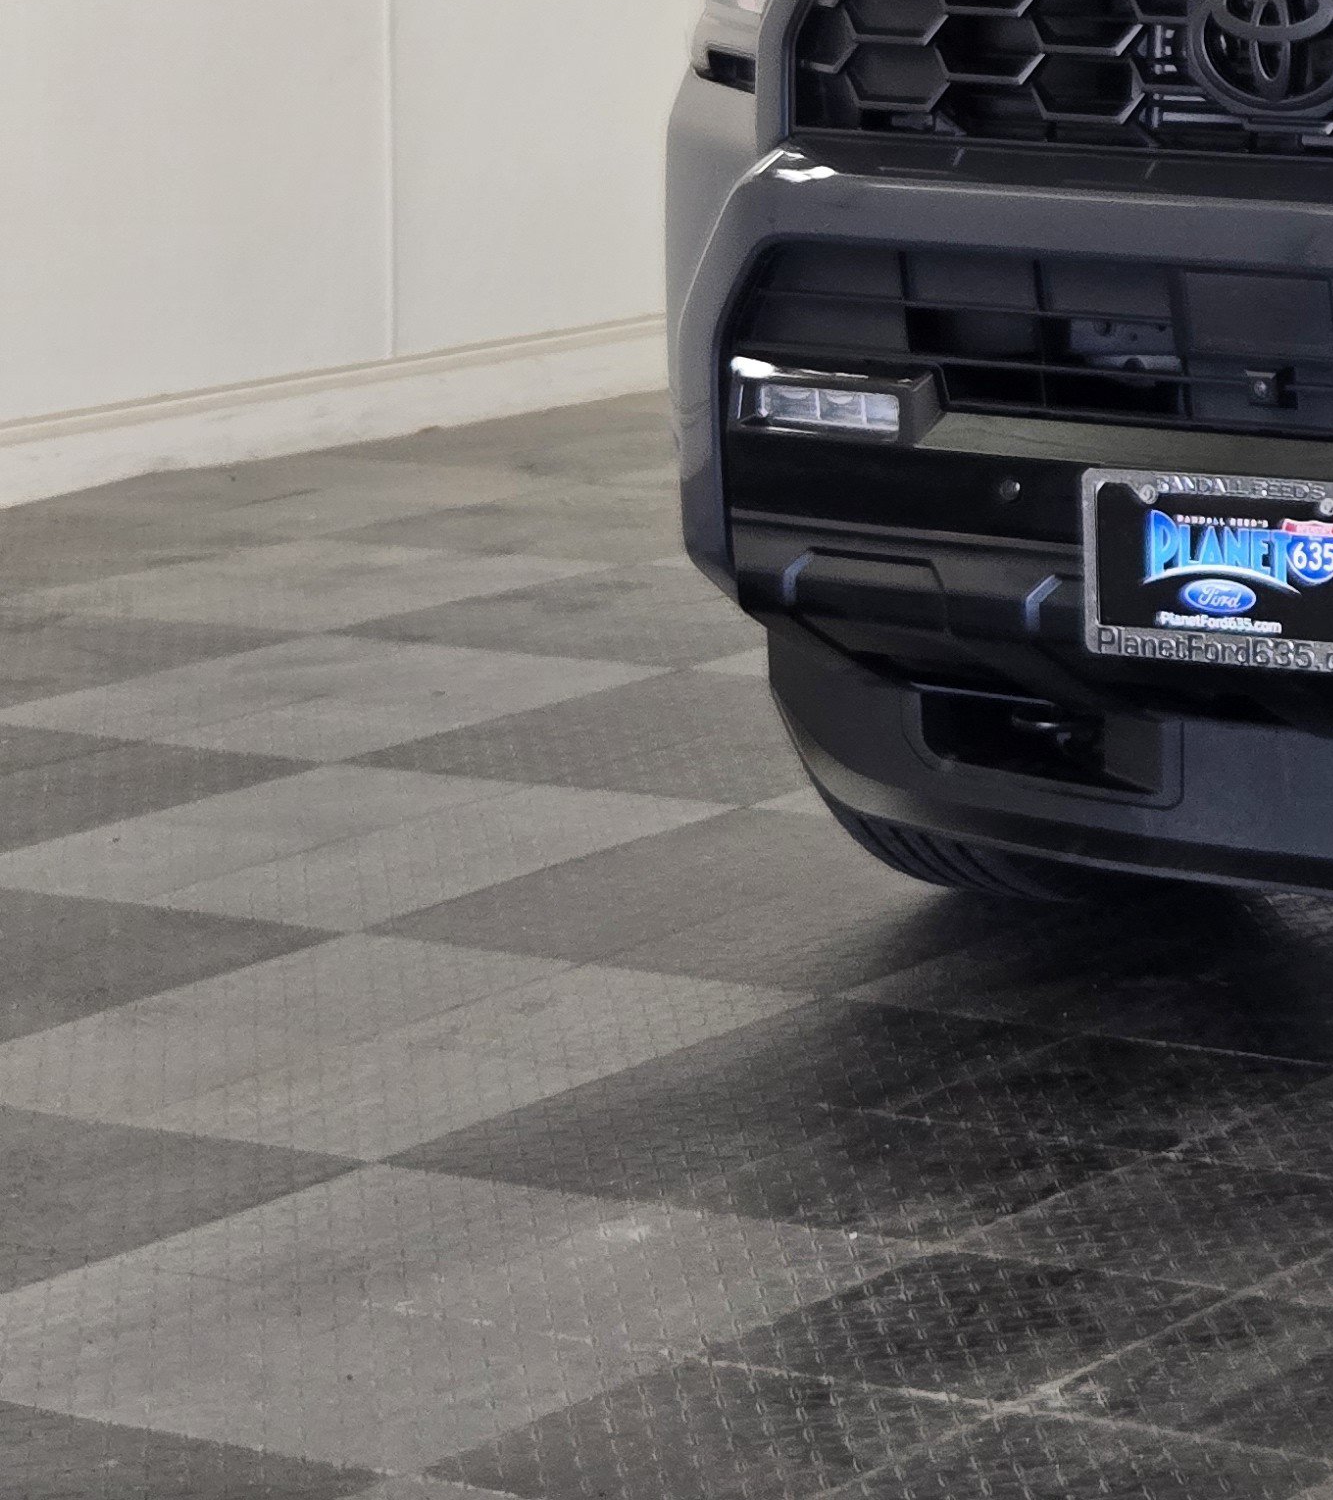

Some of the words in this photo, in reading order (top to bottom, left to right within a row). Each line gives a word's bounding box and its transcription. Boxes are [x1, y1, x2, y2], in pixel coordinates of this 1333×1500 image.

[1147, 509, 1292, 584] PLANET
[1197, 583, 1241, 609] Ford
[1159, 610, 1282, 634] PlanetFord635.com
